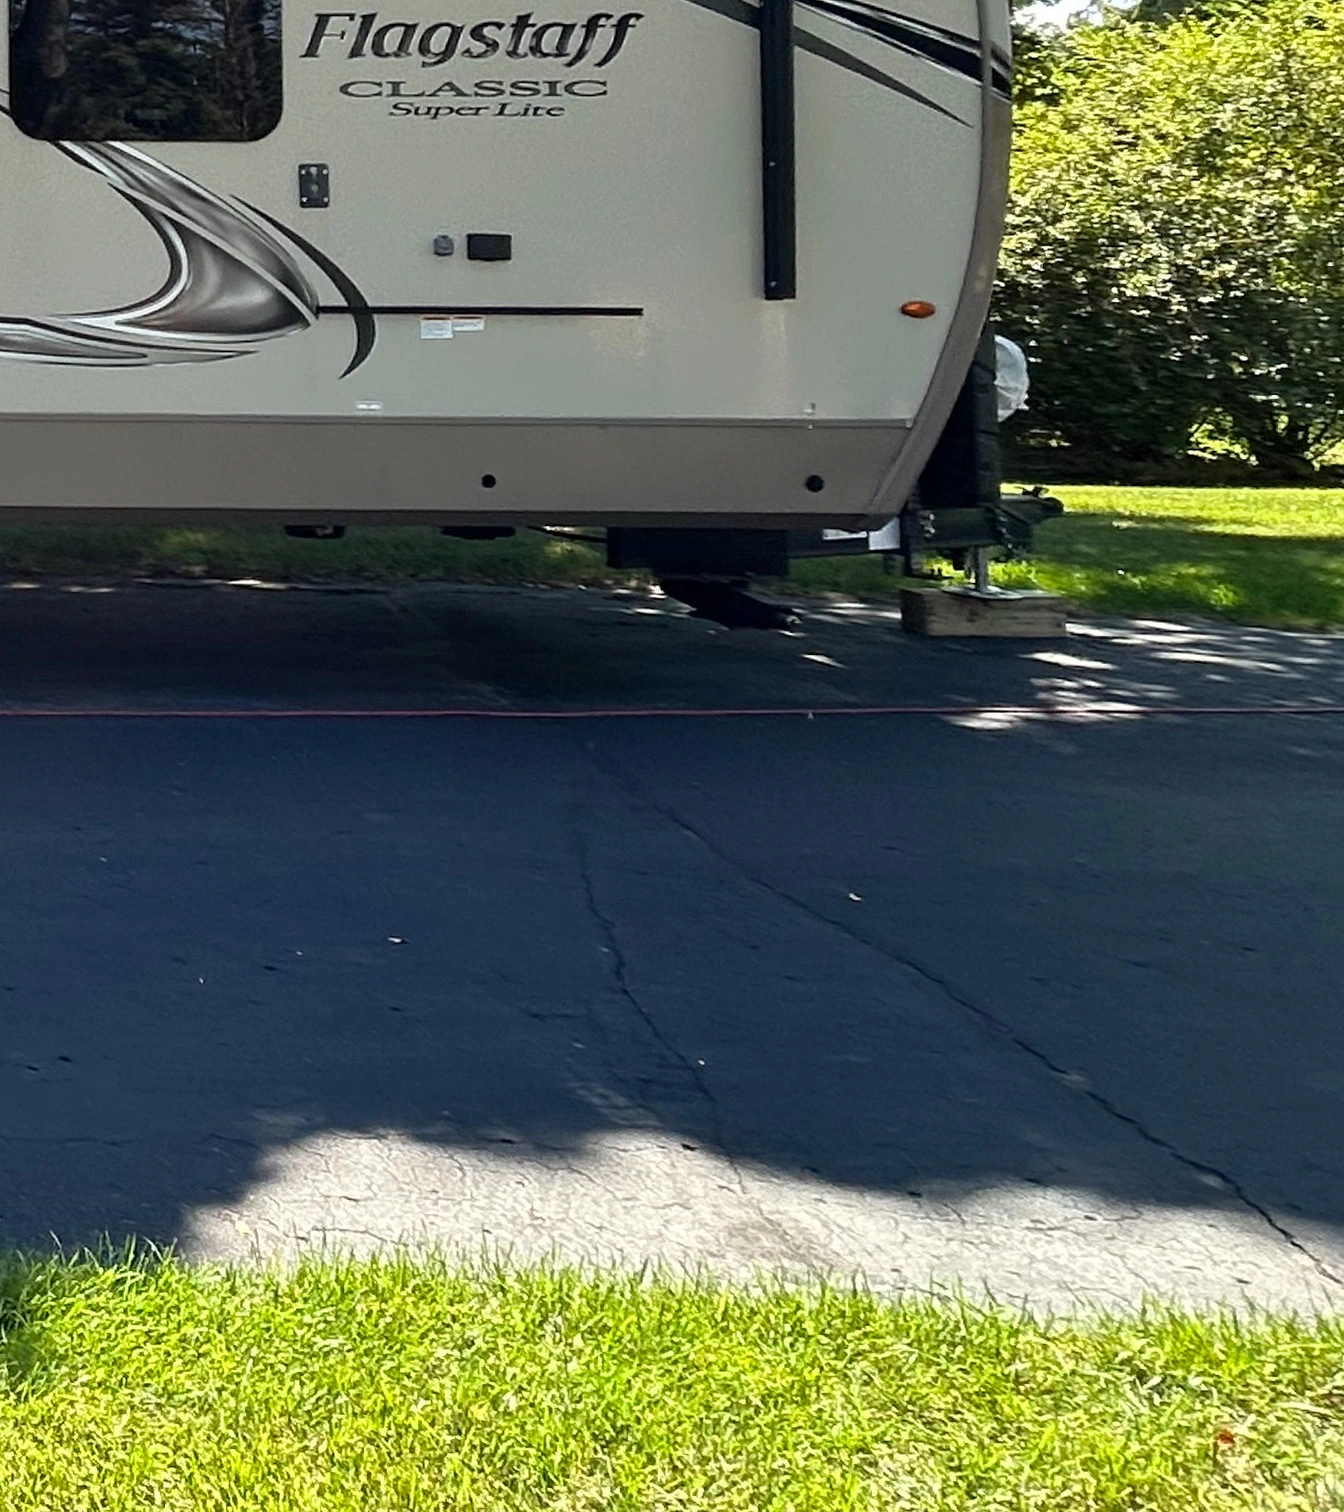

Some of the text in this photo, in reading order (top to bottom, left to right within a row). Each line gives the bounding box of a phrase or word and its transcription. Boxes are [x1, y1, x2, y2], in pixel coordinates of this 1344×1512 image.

[299, 11, 644, 68] Flagstaff
[339, 80, 608, 98] CLASSIC
[388, 102, 566, 120] Super Lite
